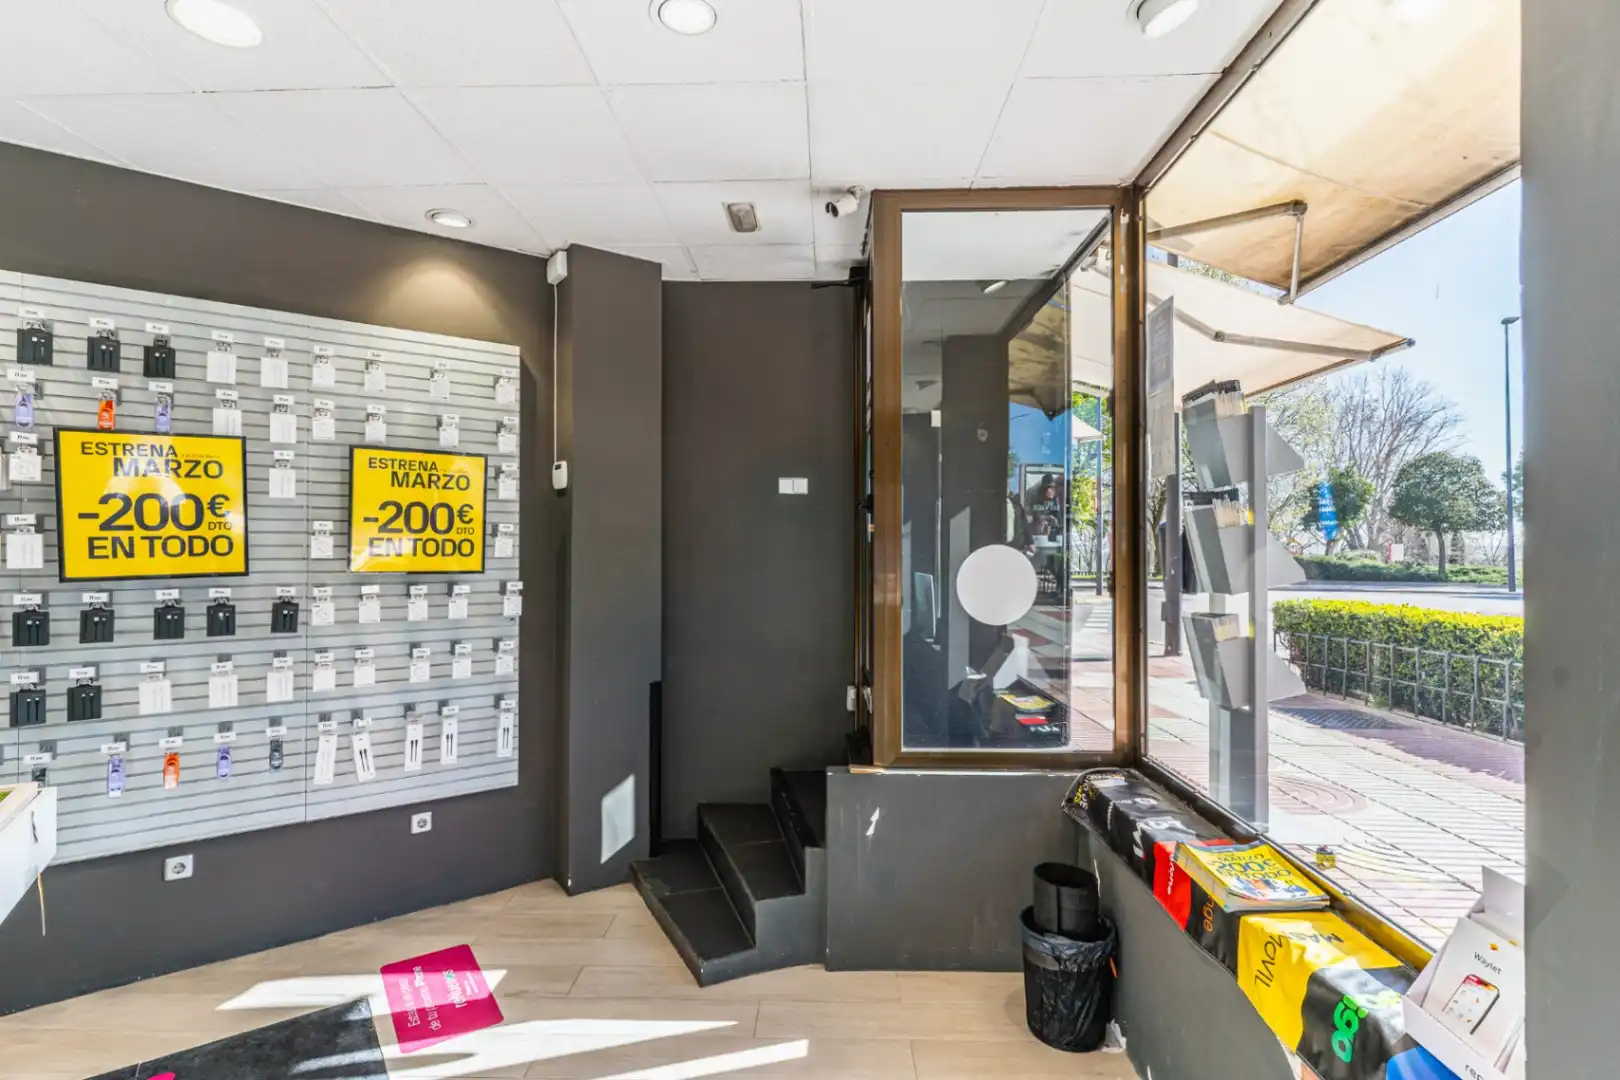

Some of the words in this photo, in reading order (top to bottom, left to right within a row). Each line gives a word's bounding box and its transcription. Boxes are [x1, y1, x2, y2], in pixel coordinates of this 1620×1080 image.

[81, 441, 178, 459] ESTRENA
[113, 457, 223, 480] MARZO
[368, 457, 438, 473] ESTRENA
[391, 471, 471, 491] MARZO
[207, 520, 233, 532] DTO
[456, 526, 475, 536] DTO
[88, 535, 135, 560] EN
[139, 534, 234, 559] TODO
[368, 537, 402, 557] EN
[406, 538, 475, 558] TODO
[1473, 951, 1503, 976] Waylet
